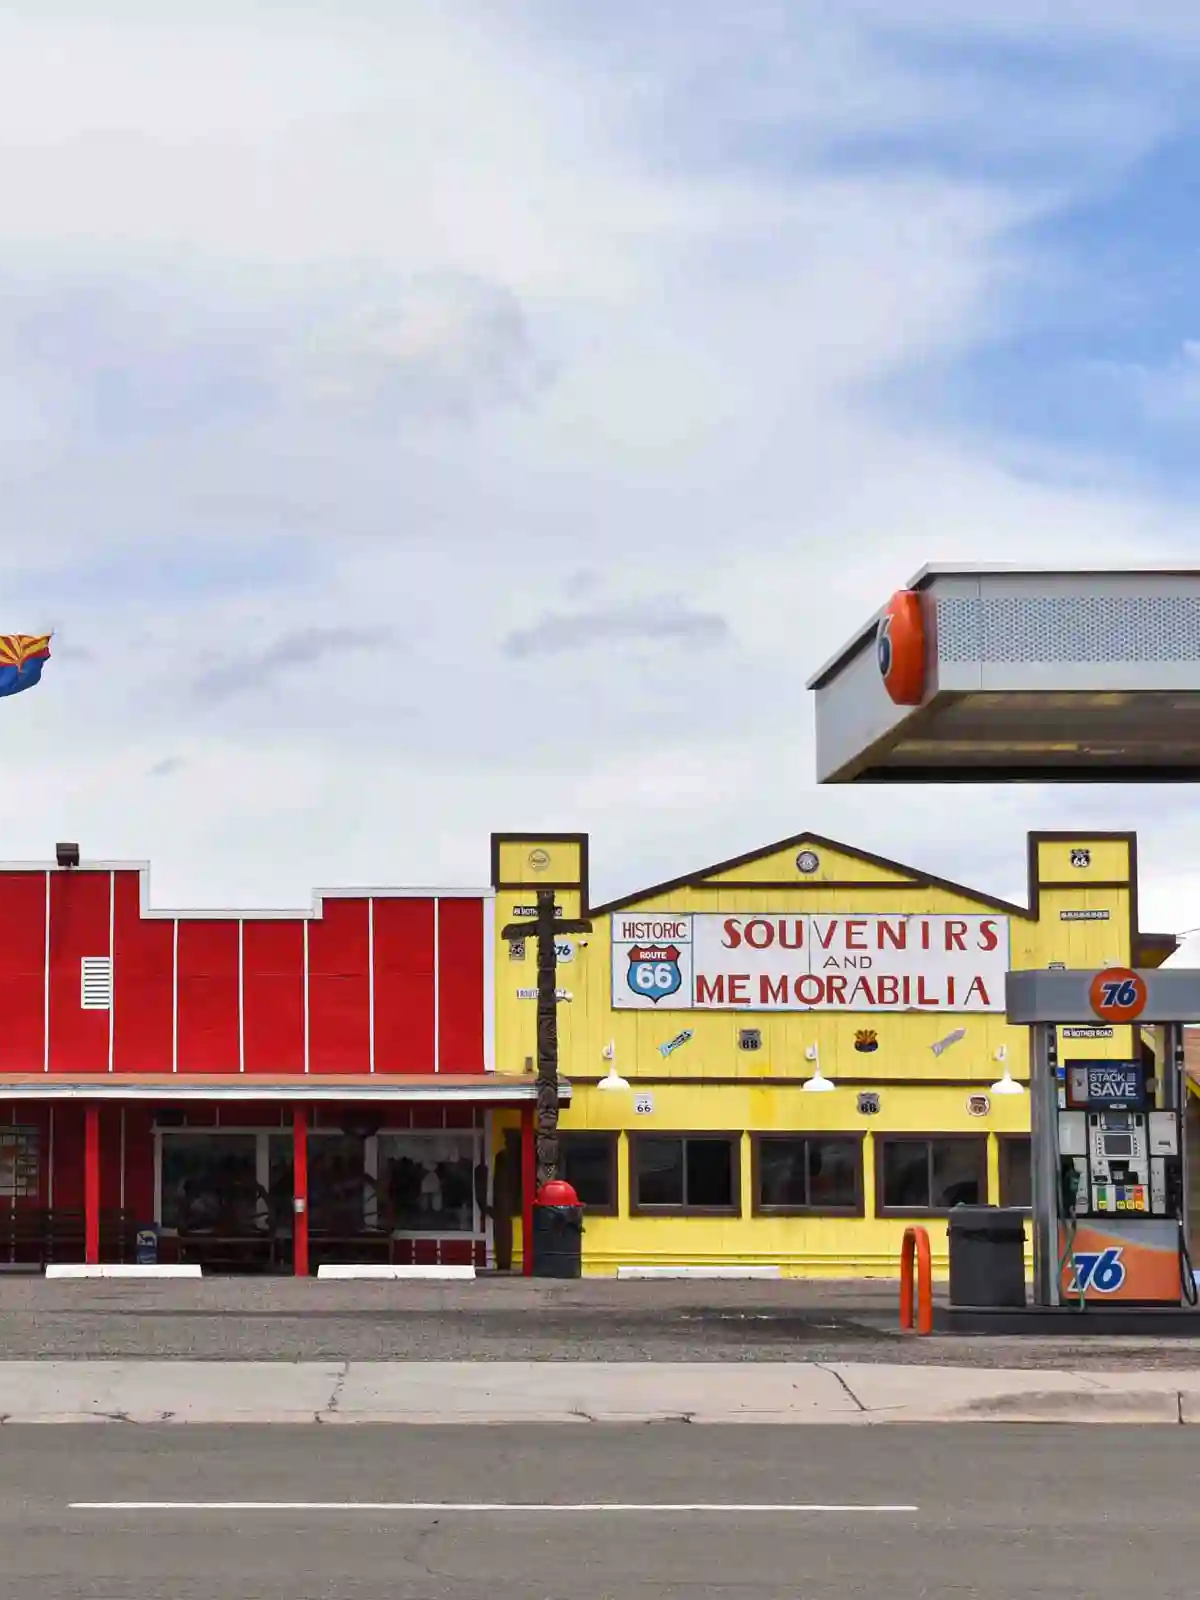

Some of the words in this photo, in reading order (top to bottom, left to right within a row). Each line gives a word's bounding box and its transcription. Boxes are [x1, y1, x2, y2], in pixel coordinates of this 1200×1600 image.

[1073, 857, 1088, 867] 66
[622, 921, 687, 940] HISTORIC
[721, 918, 998, 951] SOUVENIRS
[555, 944, 571, 957] 76
[640, 951, 667, 961] ROUTE
[823, 955, 873, 969] AND
[635, 962, 674, 990] 66
[695, 973, 991, 1006] MEMORABILIA
[1100, 978, 1138, 1008] 76
[1090, 1073, 1125, 1082] STACK
[1090, 1082, 1137, 1097] SAVE
[637, 1104, 651, 1113] 66
[1068, 1247, 1126, 1293] 76
